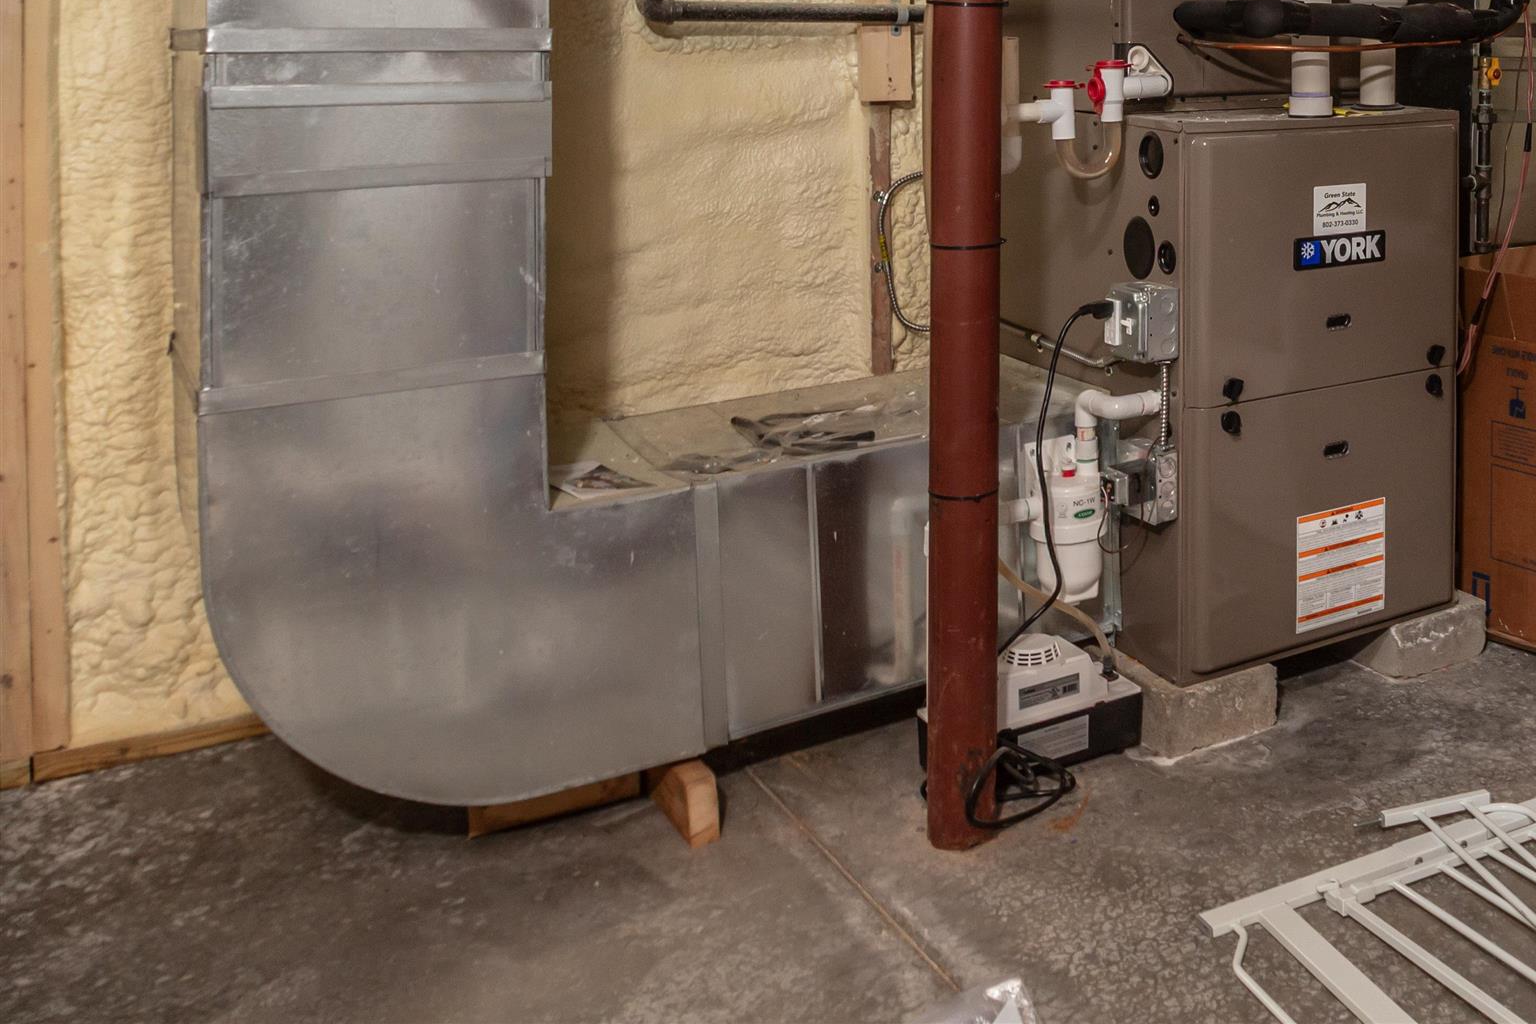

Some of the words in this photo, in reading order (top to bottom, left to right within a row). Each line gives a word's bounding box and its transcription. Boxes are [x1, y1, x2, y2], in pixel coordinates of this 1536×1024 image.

[1324, 191, 1341, 199] Green
[1320, 234, 1382, 264] YORK
[1073, 496, 1096, 507] NC-1W
